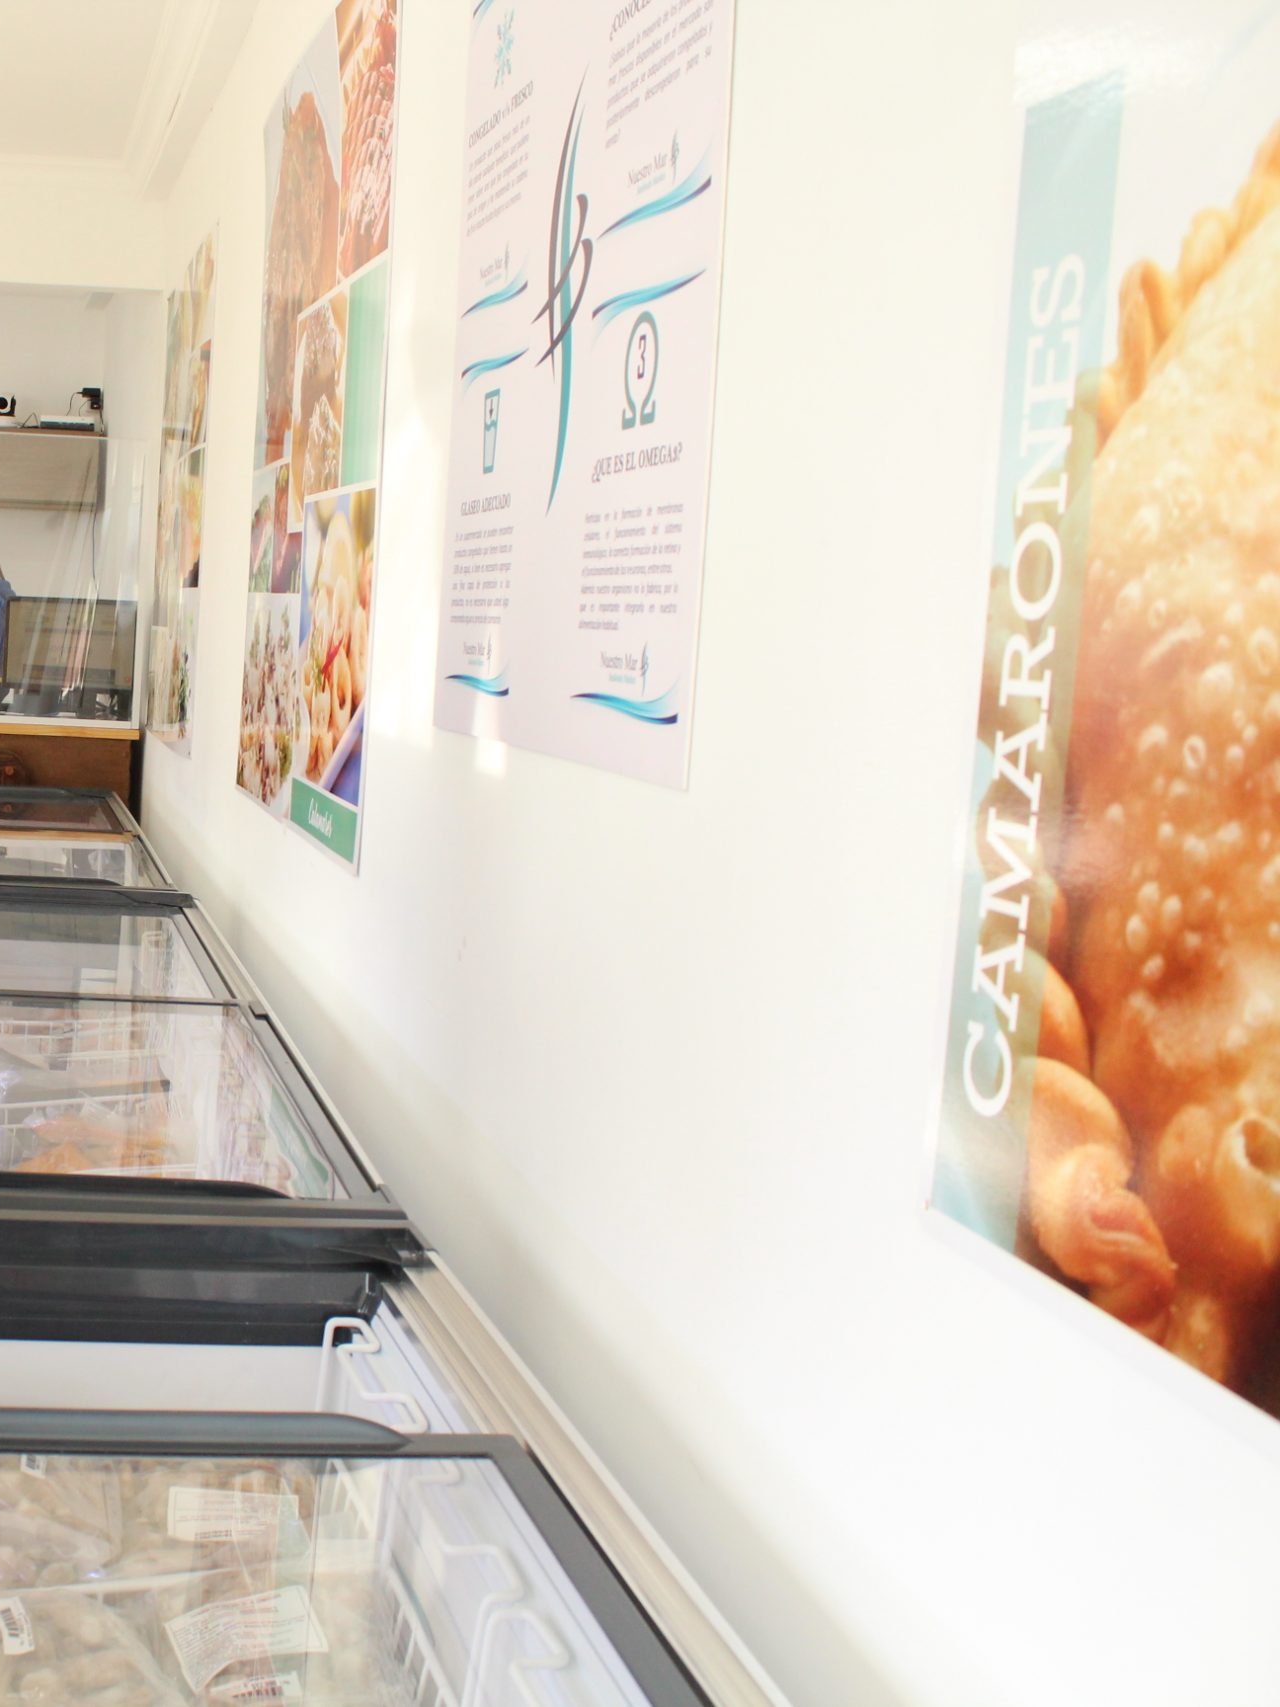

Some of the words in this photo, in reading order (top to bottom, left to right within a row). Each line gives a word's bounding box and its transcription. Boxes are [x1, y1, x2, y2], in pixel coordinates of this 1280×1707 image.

[637, 334, 648, 380] 3
[613, 454, 624, 475] ES
[625, 451, 636, 472] EL
[962, 252, 1086, 1119] CAMARONES
